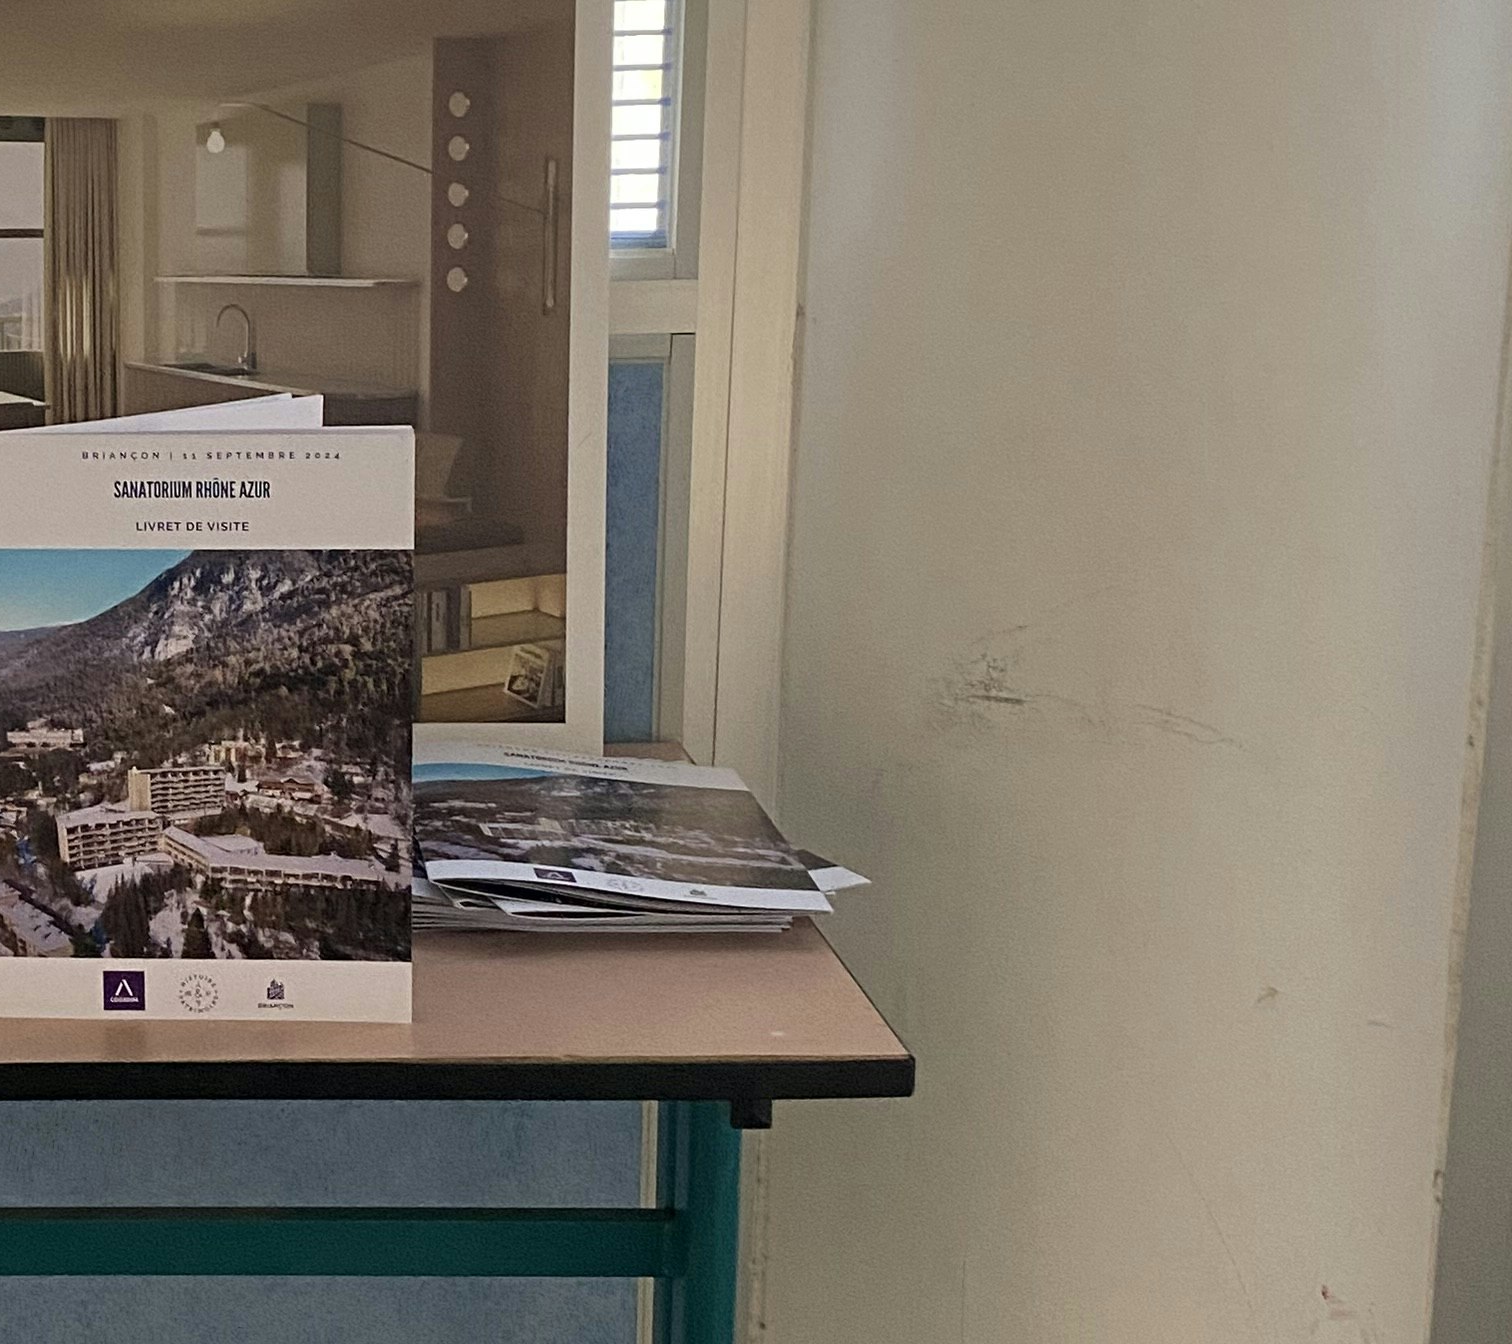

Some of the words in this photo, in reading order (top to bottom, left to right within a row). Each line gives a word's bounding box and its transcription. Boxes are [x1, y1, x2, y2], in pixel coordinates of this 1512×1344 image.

[81, 451, 161, 462] BRIANÇON
[182, 452, 197, 460] 11
[206, 451, 296, 460] SEPTEMBRE
[305, 452, 340, 460] 2024
[113, 480, 193, 499] SANATORIUM
[195, 477, 237, 499] RHÔNE
[238, 480, 271, 499] AZUR
[135, 521, 182, 532] LIVRET
[185, 521, 203, 532] DE
[206, 521, 250, 532] VISITE
